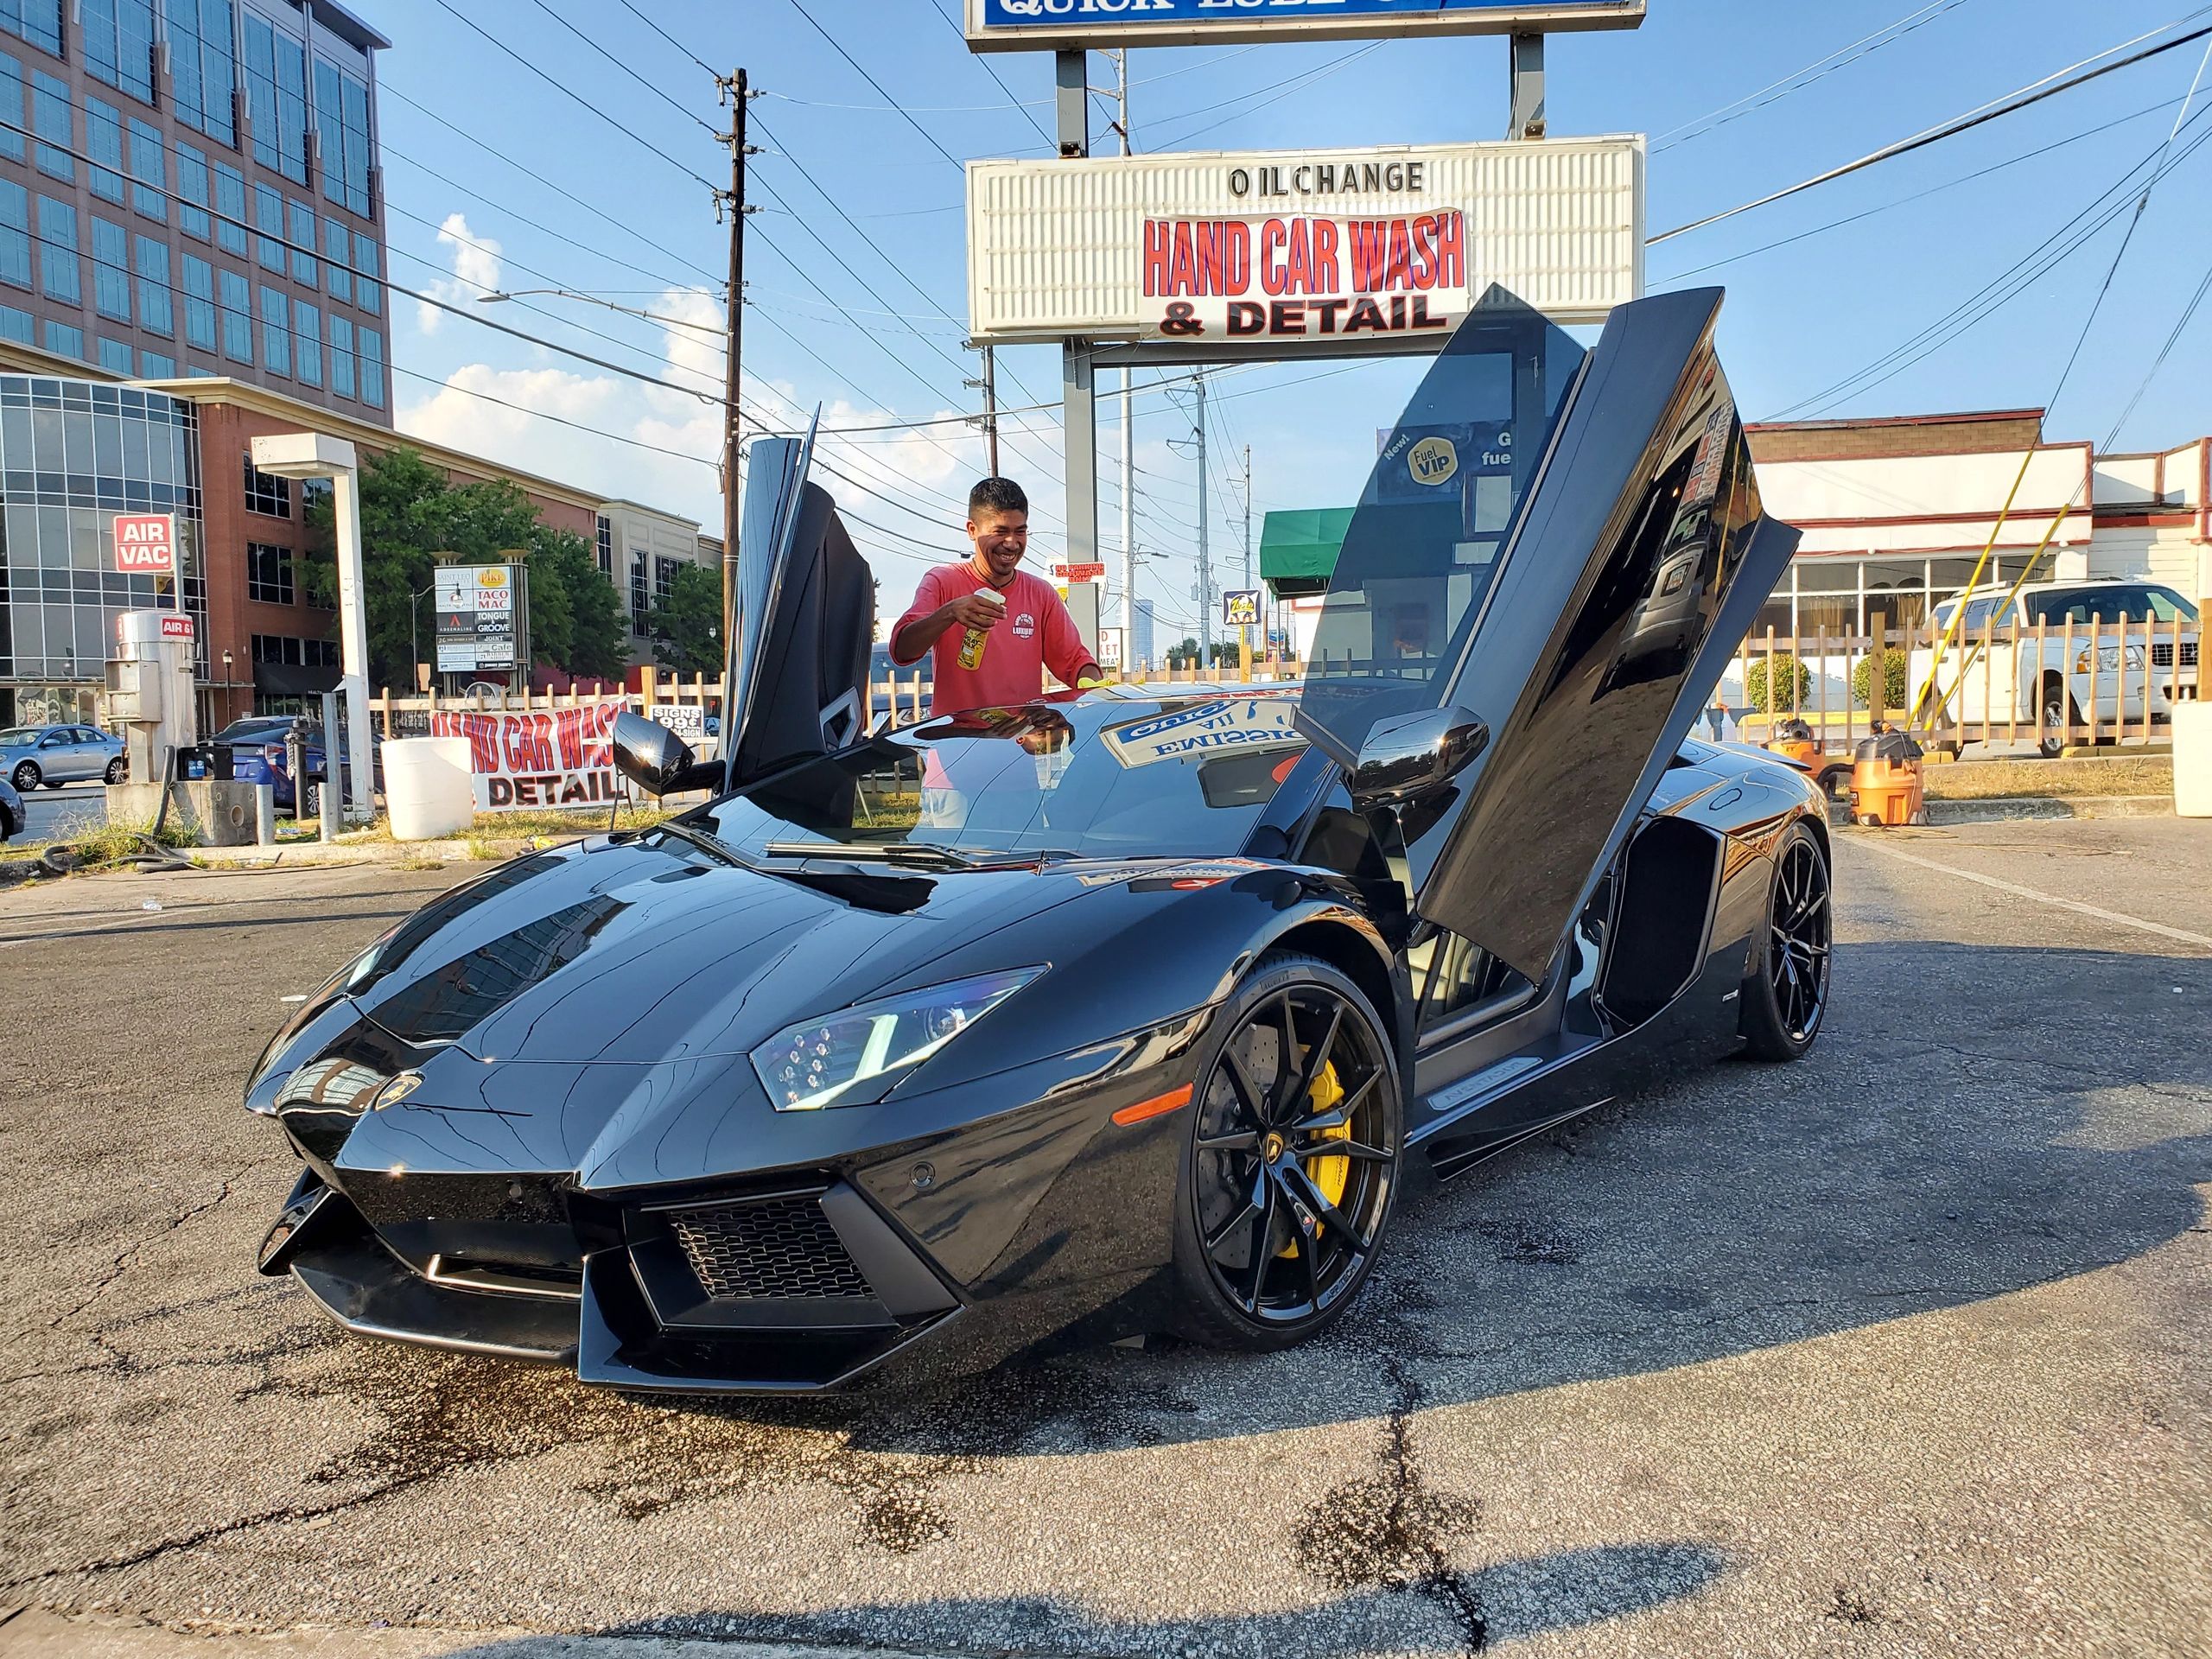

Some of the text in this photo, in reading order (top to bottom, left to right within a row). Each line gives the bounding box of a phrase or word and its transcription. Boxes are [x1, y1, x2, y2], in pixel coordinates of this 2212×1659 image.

[1143, 210, 1465, 296] HAND CAR WASH
[1159, 295, 1448, 337] & DETAIL
[1383, 433, 1411, 461] New!
[1414, 445, 1438, 464] Fuel
[1417, 455, 1450, 477] VIP
[123, 522, 164, 542] AIR
[119, 545, 169, 565] VAC
[1067, 563, 1105, 571] PARKING
[477, 590, 509, 601] TACO
[478, 600, 508, 609] MAC
[477, 612, 510, 620] TONGUE
[162, 621, 182, 633] AIR
[477, 623, 511, 632] GROOVE
[1101, 631, 1109, 642] D
[653, 709, 701, 719] SIGNS
[502, 713, 555, 774] CAR
[487, 770, 629, 809] DETAIL
